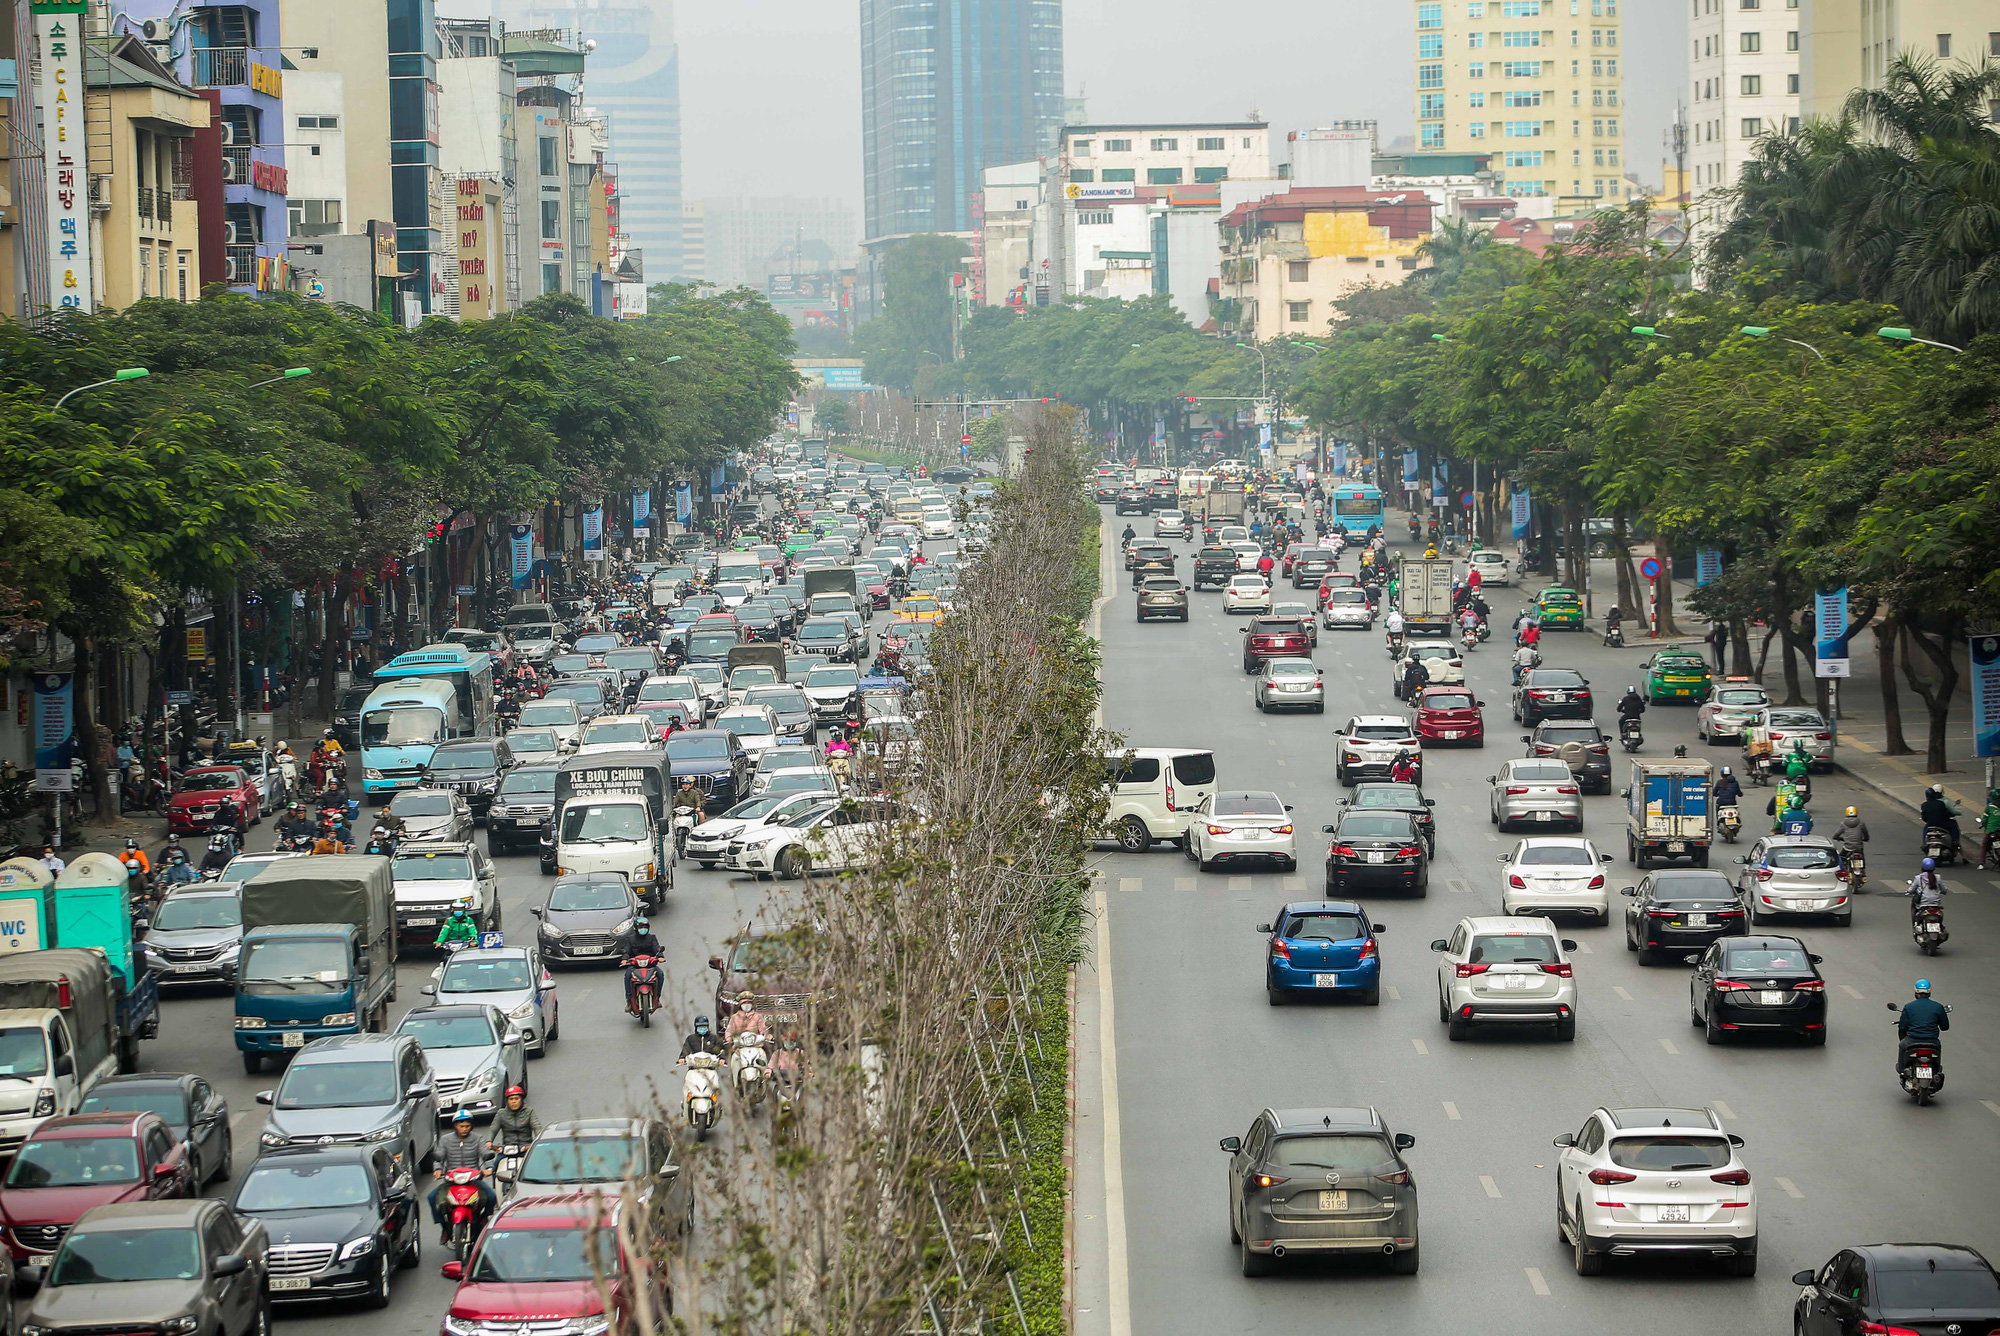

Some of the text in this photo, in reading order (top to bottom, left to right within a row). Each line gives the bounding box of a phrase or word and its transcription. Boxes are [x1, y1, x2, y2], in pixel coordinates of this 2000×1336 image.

[50, 21, 67, 61] 소주
[56, 68, 69, 142] CAFE
[58, 150, 76, 211] 노래방
[59, 217, 78, 260] 맥주
[570, 767, 644, 783] XE BƯU CHÍNH
[0, 920, 26, 936] WC
[1325, 1190, 1341, 1200] 37A
[1320, 1200, 1348, 1209] 431.96
[1665, 1204, 1681, 1213] 20A
